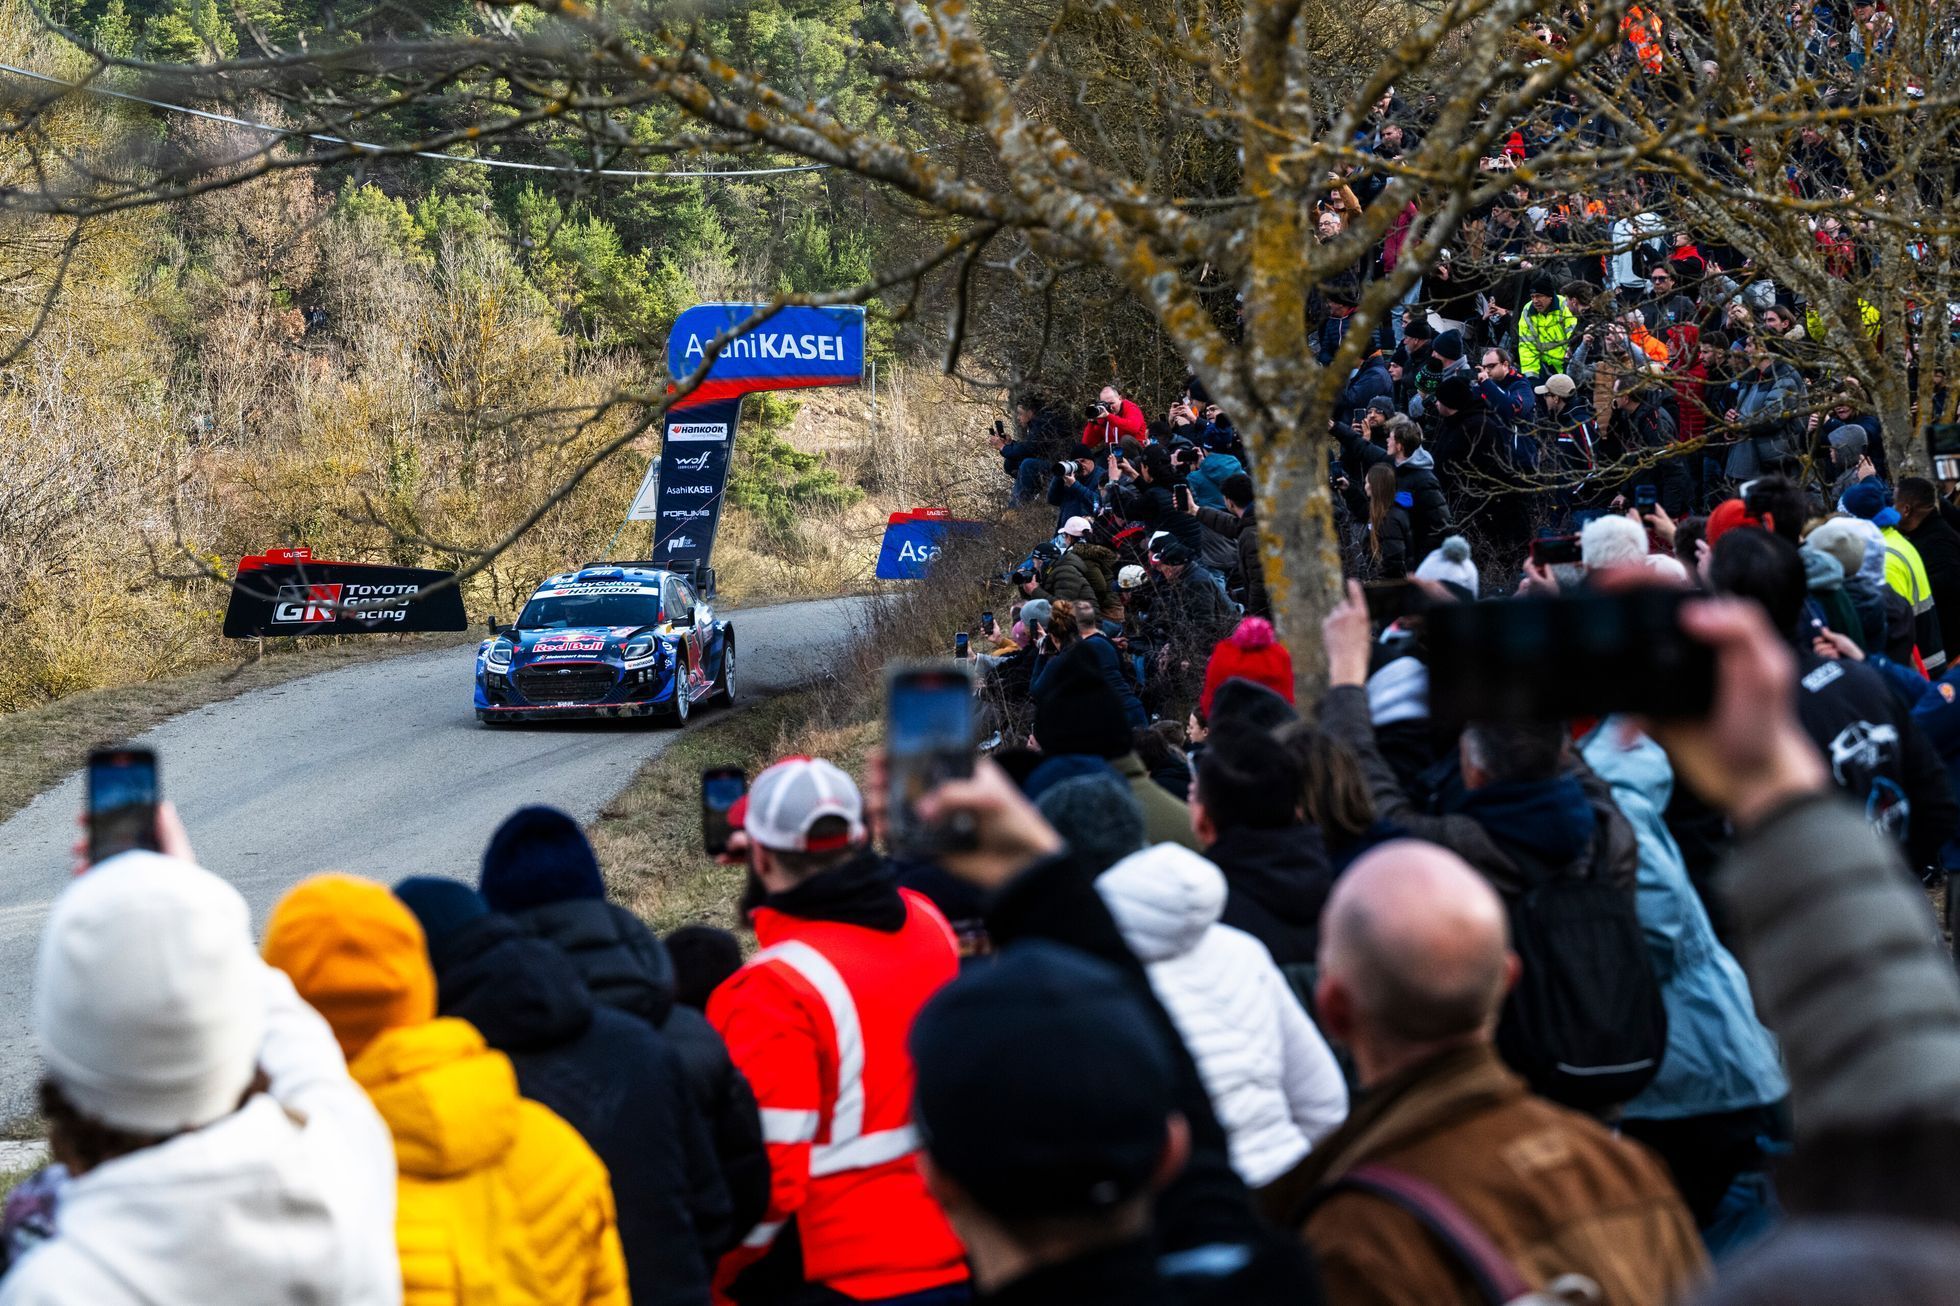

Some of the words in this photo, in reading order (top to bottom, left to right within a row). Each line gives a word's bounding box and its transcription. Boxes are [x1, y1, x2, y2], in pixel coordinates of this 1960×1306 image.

[666, 485, 713, 495] AsahiKASEI
[346, 584, 418, 596] TOYOTA
[343, 608, 406, 621] acing
[532, 642, 568, 653] Red
[568, 641, 605, 651] Bull
